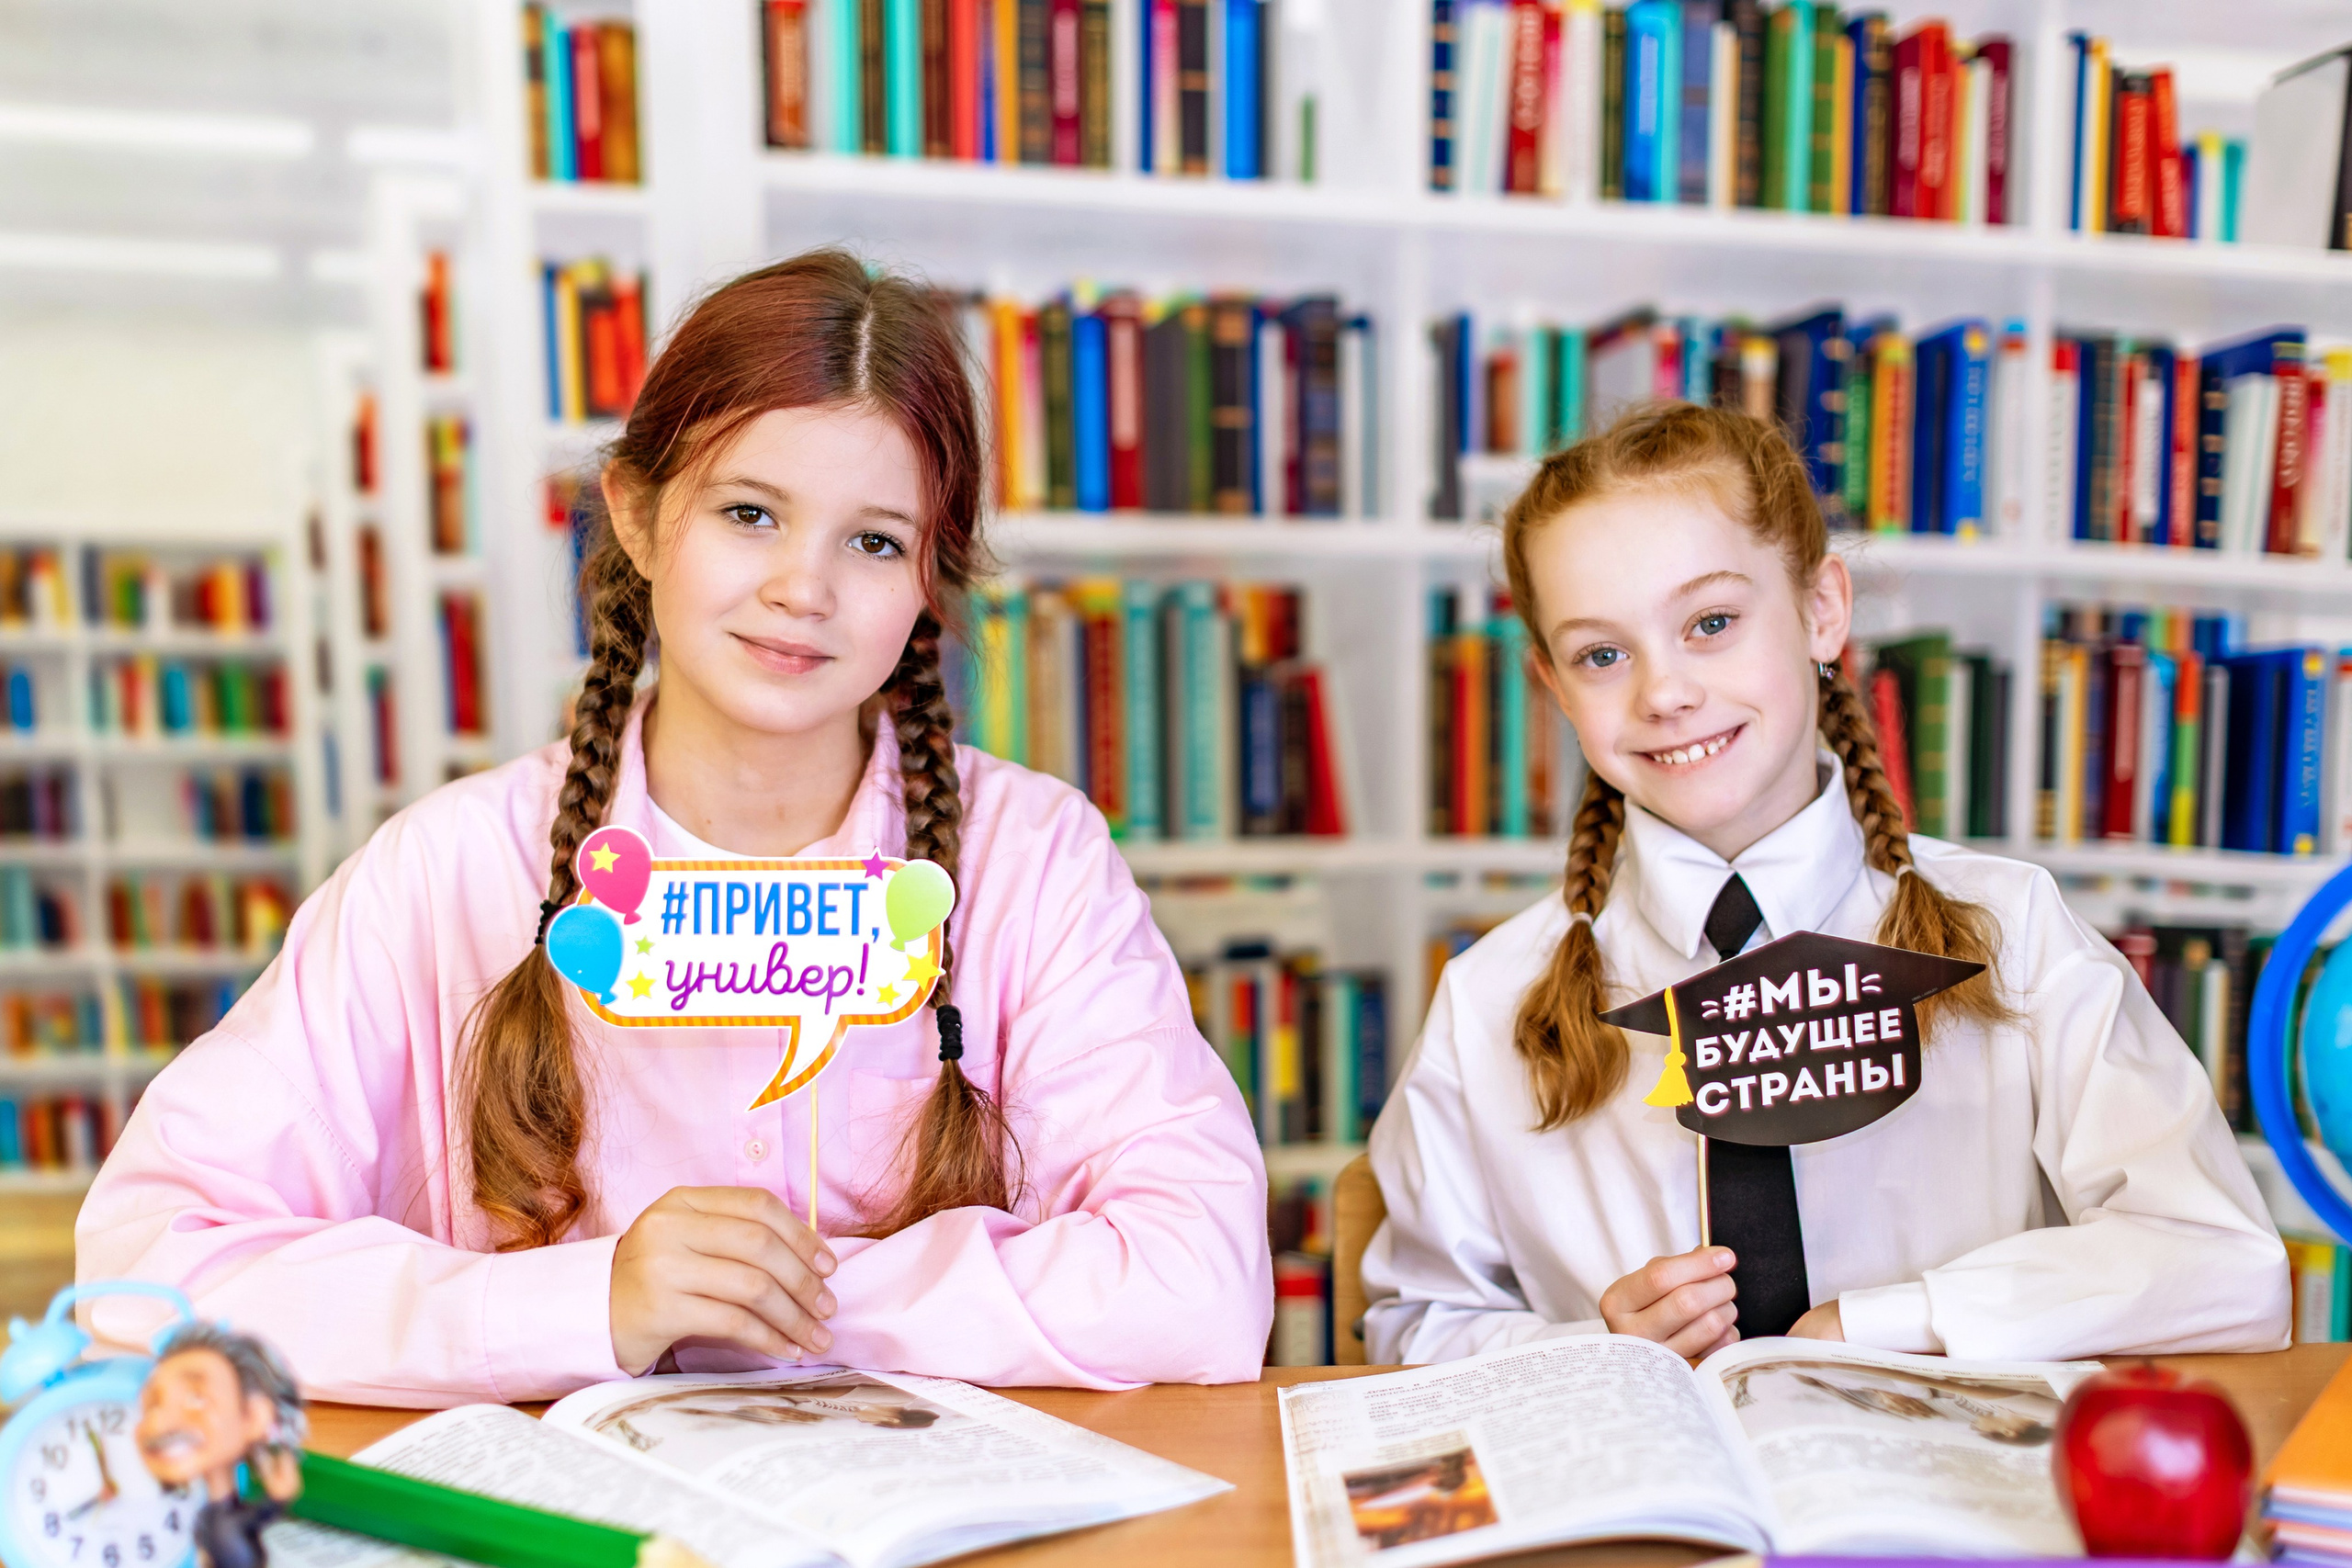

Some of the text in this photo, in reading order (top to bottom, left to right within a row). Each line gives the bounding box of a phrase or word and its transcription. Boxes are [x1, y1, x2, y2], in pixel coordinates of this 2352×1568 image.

[662, 881, 879, 942] #ПРИВЕТ,
[665, 941, 870, 1015] универ!
[1723, 963, 1860, 1021] #МЫ
[1695, 1008, 1903, 1068] БУДУЩЕЕ
[1696, 1053, 1905, 1115] СТРАНЫ
